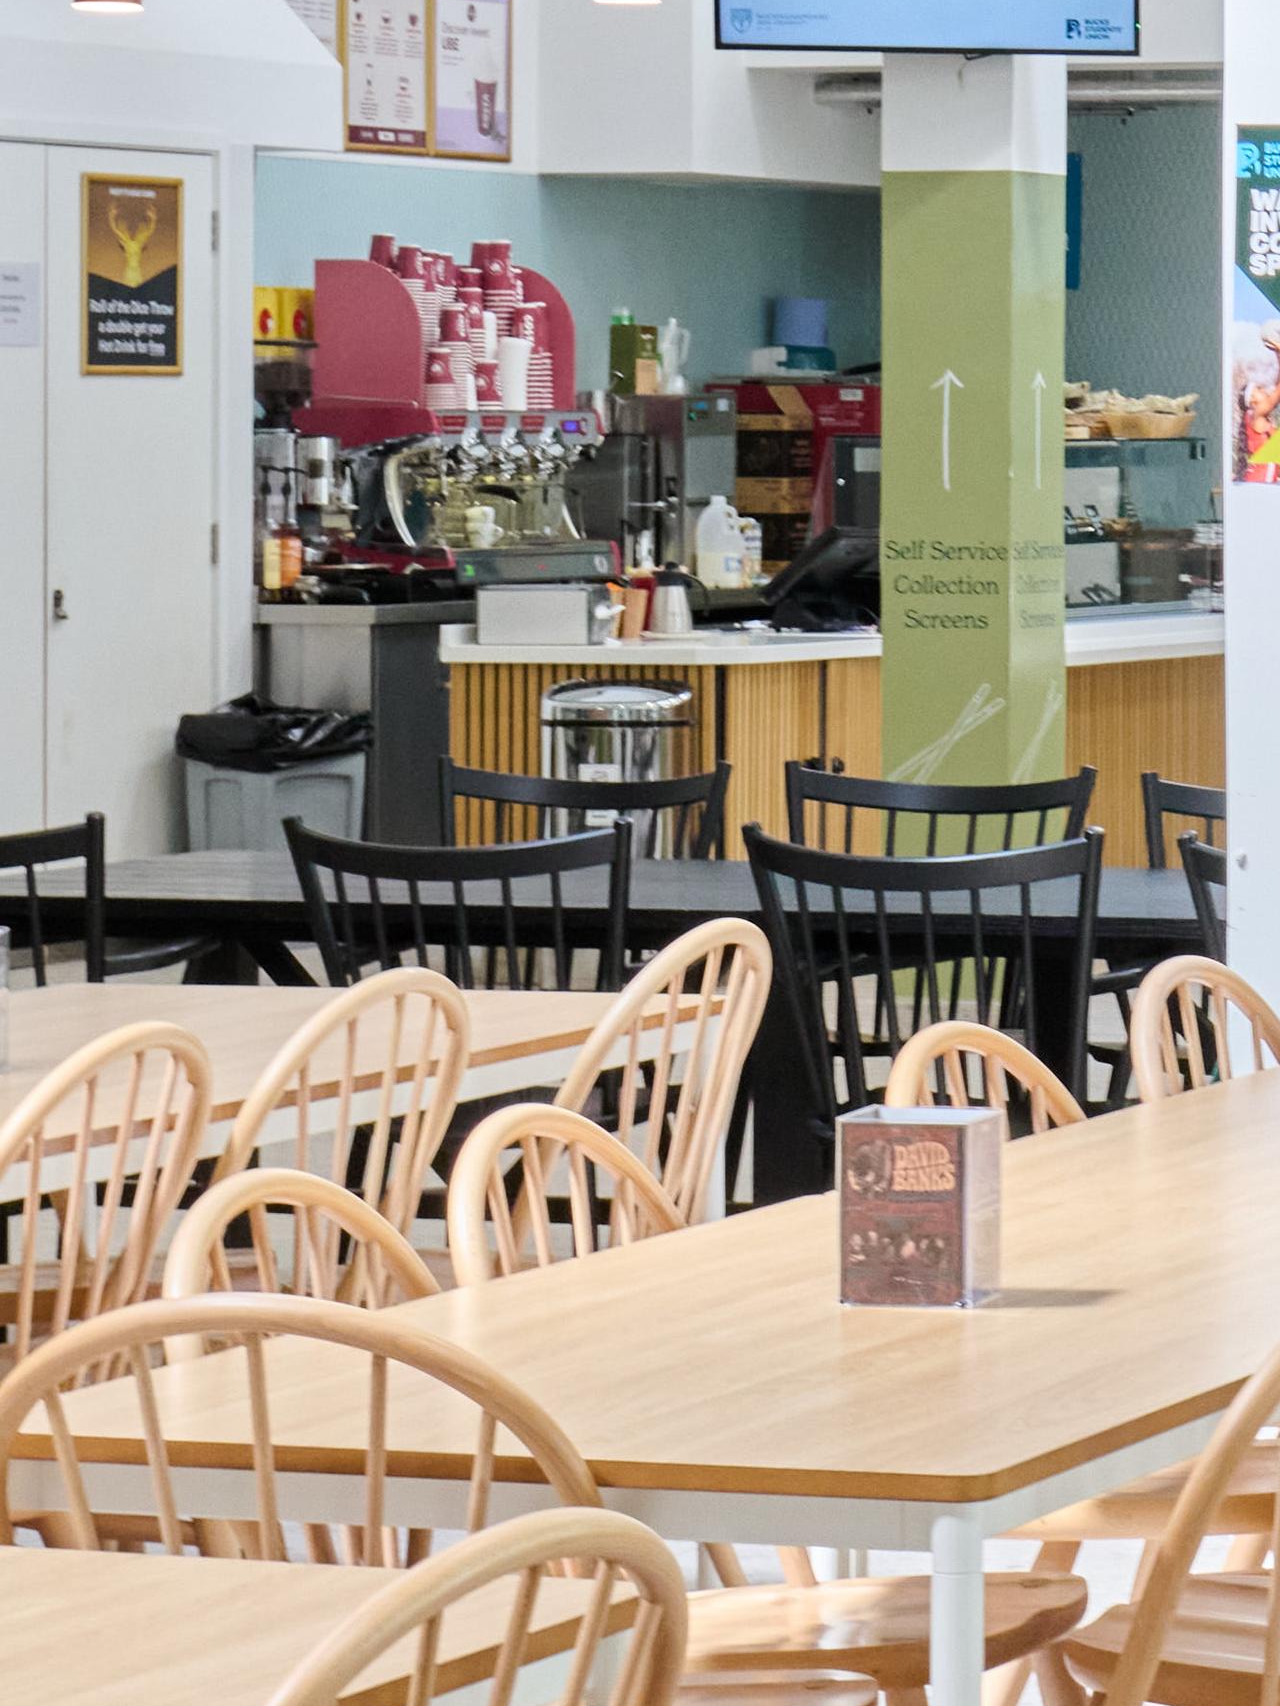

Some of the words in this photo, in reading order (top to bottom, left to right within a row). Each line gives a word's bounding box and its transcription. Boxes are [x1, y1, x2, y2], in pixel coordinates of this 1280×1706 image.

[886, 540, 926, 561] Self
[931, 541, 1009, 562] Service
[894, 573, 999, 595] Collection
[905, 609, 989, 630] Screens
